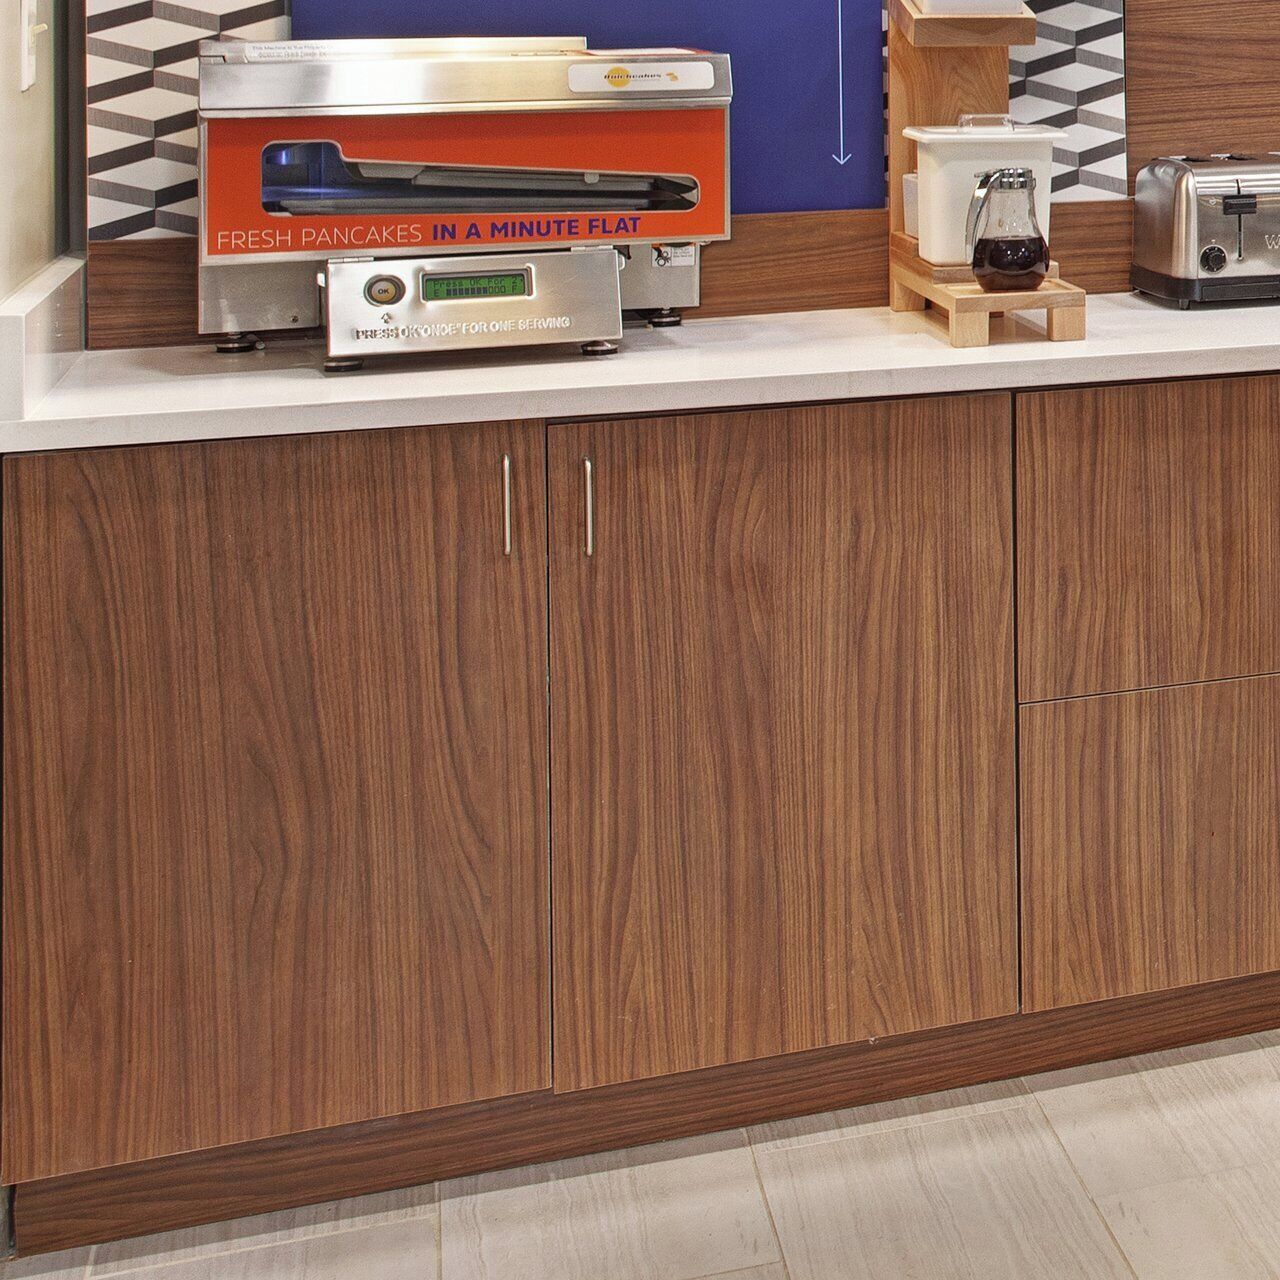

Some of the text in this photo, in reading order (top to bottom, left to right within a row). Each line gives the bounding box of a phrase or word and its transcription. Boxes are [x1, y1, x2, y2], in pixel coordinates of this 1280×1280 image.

[217, 216, 641, 250] FRESH PANCAKES IN A MINUTE FLAT
[432, 279, 464, 289] Press
[355, 326, 399, 340] PRESS
[490, 319, 516, 333] ONE
[518, 316, 571, 331] SERVING
